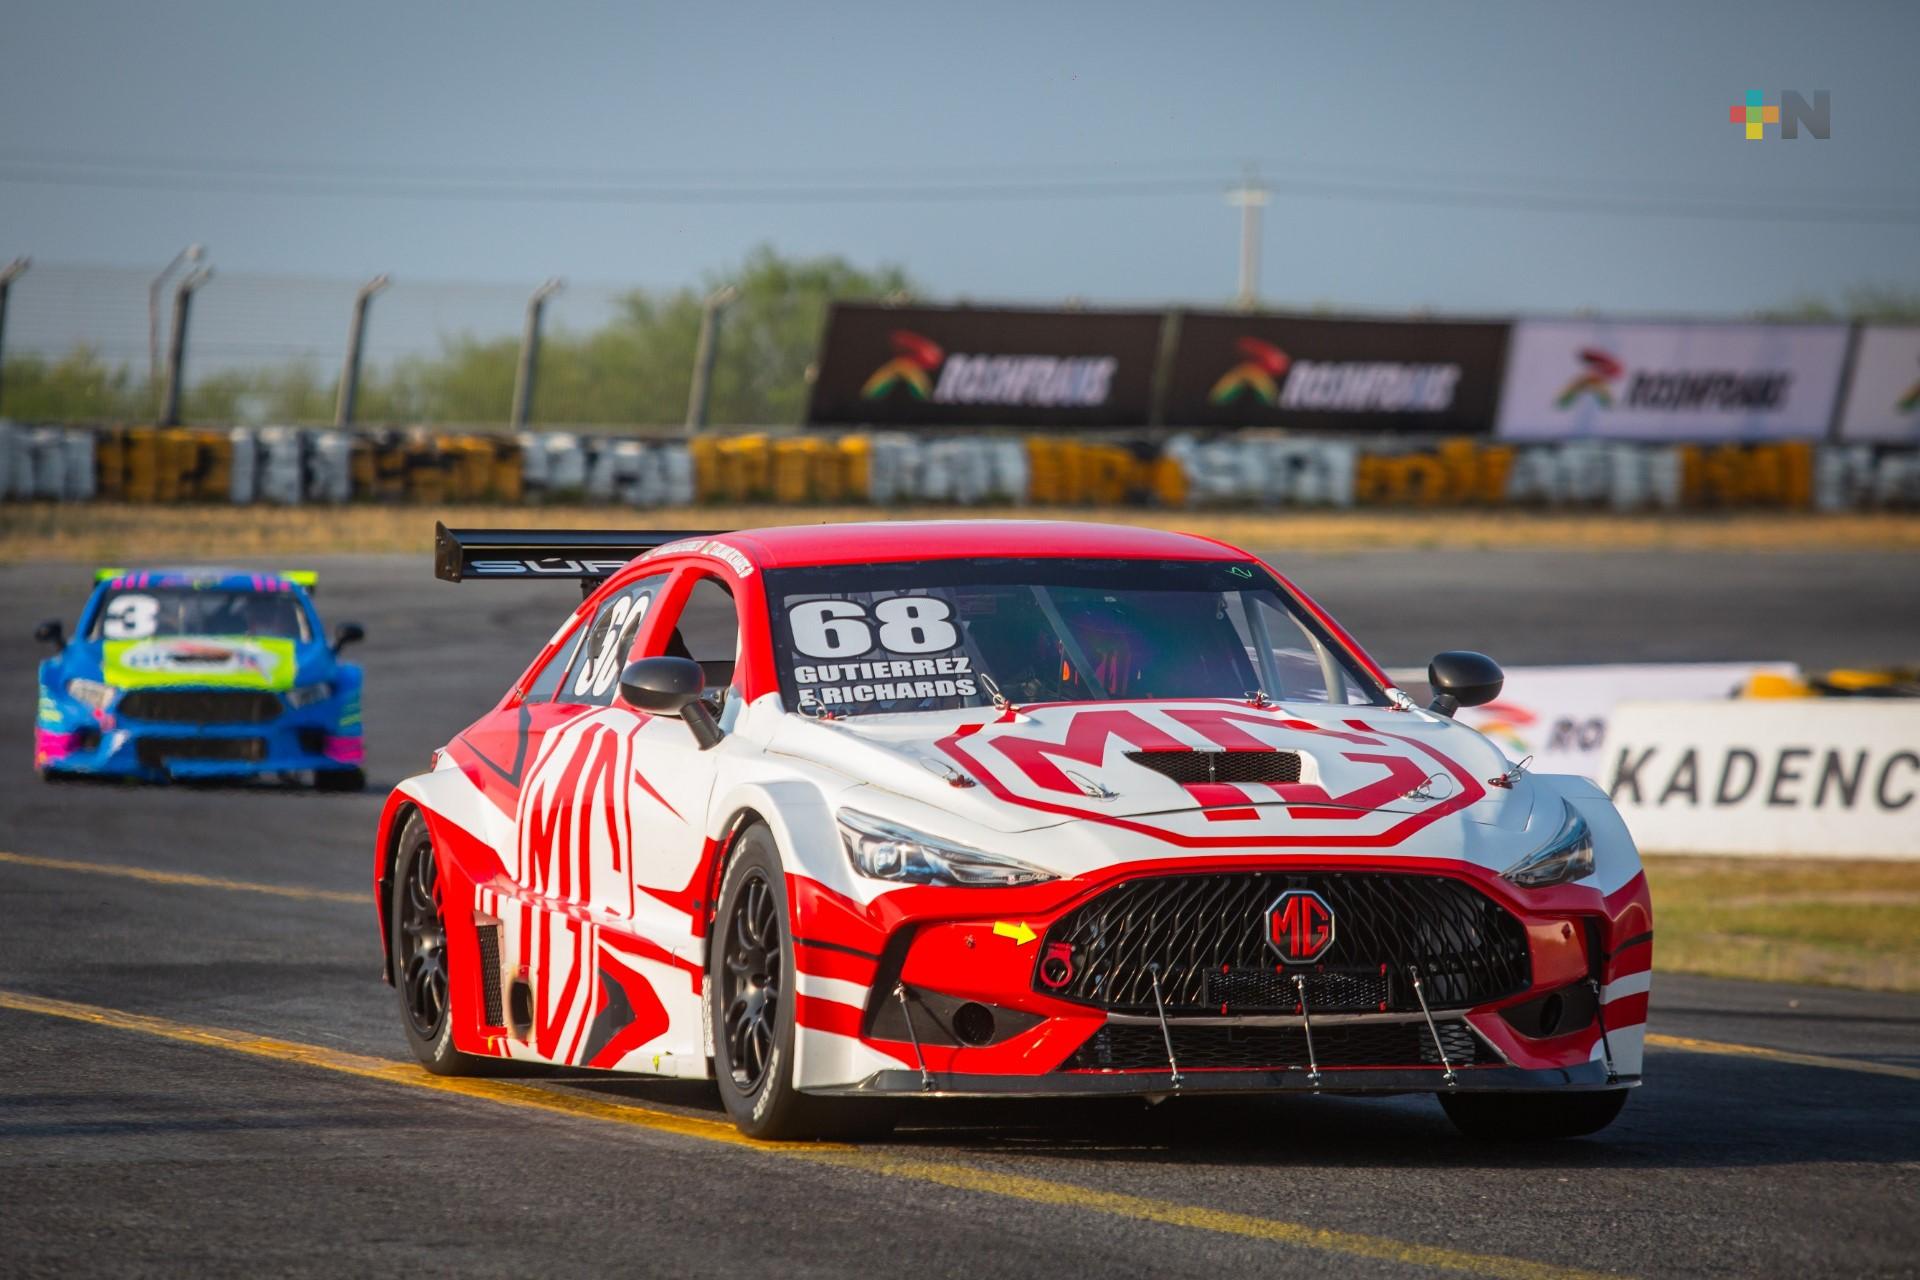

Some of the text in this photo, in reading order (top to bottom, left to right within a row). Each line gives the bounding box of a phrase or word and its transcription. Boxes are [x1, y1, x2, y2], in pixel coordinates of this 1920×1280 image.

[103, 595, 160, 640] 3
[789, 597, 957, 659] 68
[794, 656, 972, 684] GUTIERREZ
[822, 678, 977, 705] RICHARDS
[1610, 747, 1920, 811] KADENC
[1271, 895, 1329, 957] MG
